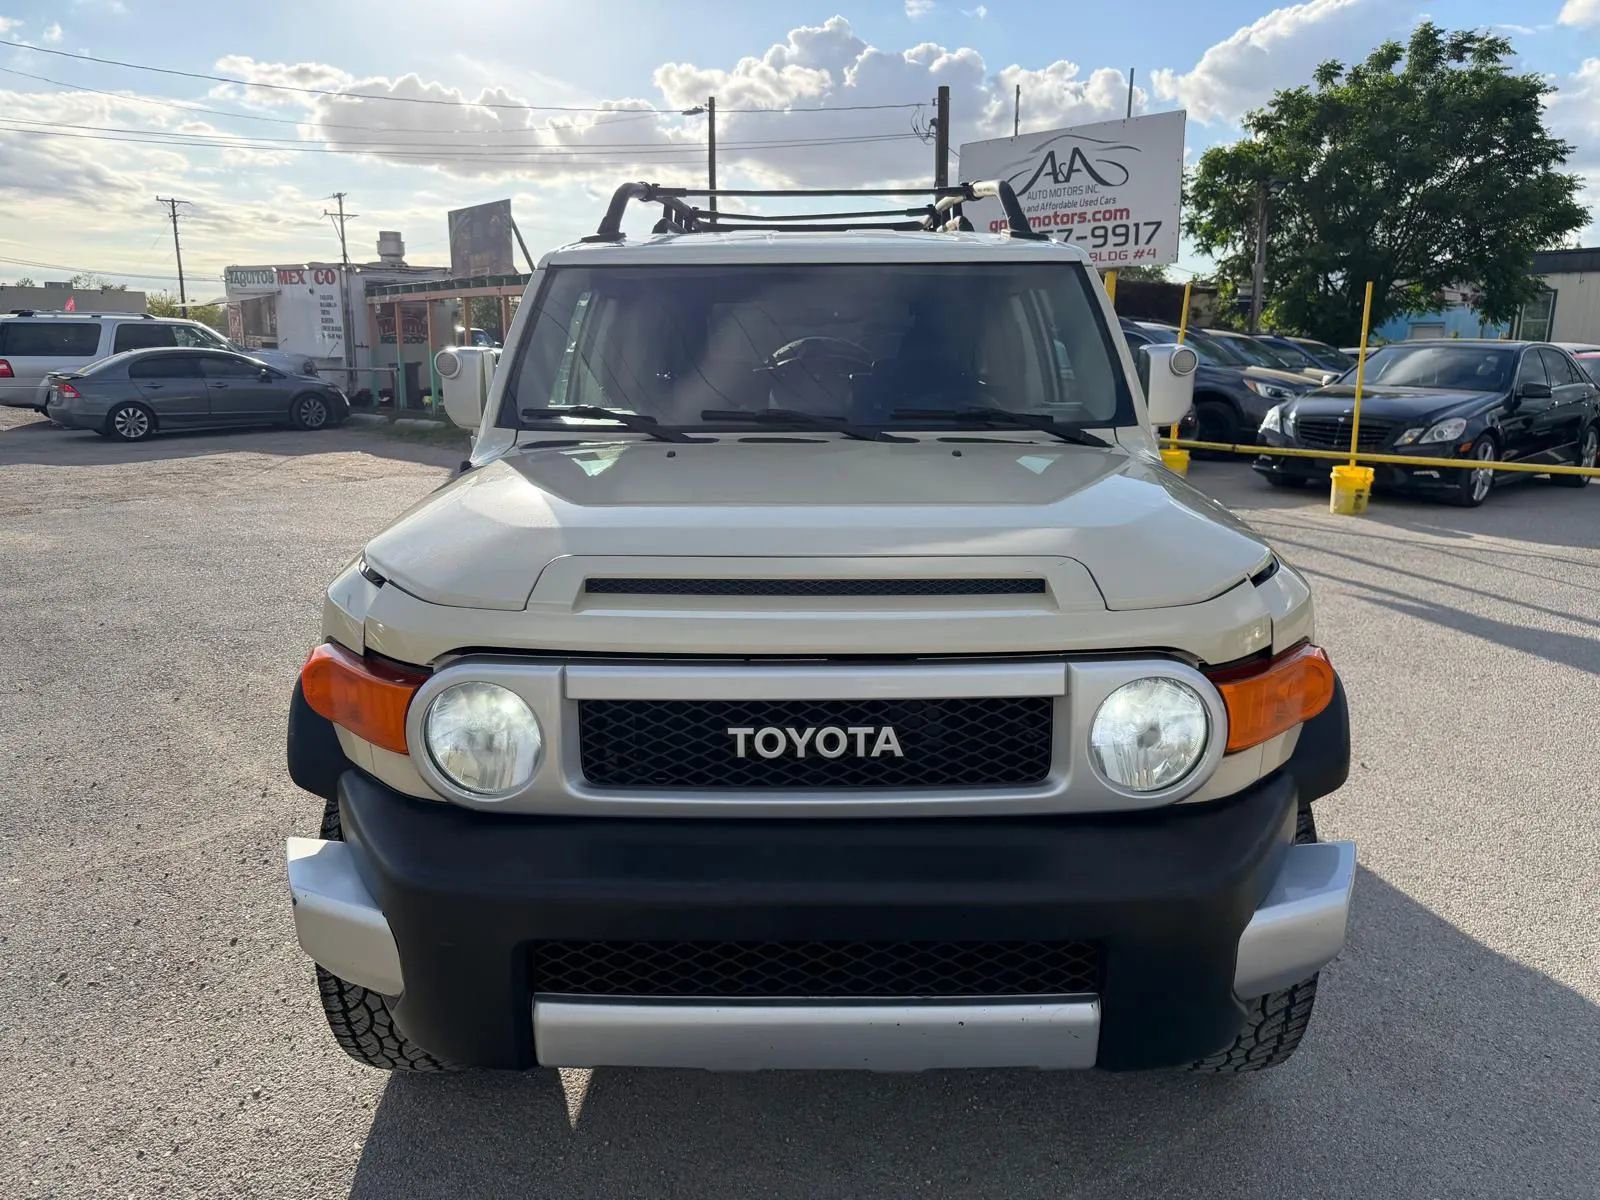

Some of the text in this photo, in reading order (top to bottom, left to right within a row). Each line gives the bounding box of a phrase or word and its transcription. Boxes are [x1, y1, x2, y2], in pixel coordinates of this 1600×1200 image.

[1027, 190, 1048, 200] AUTO
[1049, 186, 1083, 198] MOTORS
[1040, 200, 1078, 211] Affordable
[1080, 198, 1098, 207] Used
[1100, 196, 1116, 205] Cars
[990, 207, 1130, 232] gomotors.com
[1089, 248, 1156, 262] BLDG #4
[728, 727, 904, 758] TOYOTA
